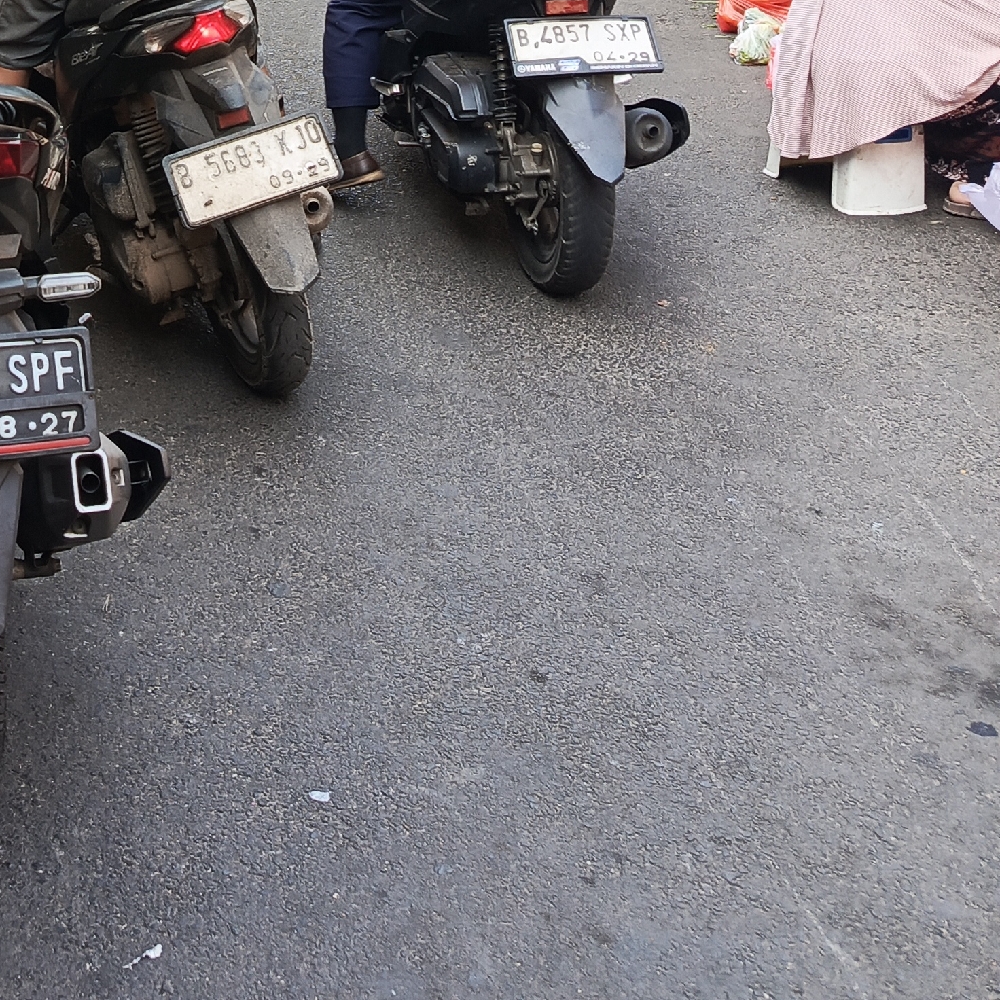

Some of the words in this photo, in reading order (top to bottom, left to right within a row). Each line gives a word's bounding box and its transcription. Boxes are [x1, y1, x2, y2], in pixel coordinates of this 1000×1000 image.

[516, 29, 529, 46] B
[541, 24, 589, 44] 4857
[604, 23, 641, 41] SXP
[526, 63, 556, 72] YAMAHA
[174, 163, 193, 189] B
[206, 140, 265, 177] 5683
[8, 350, 73, 394] SPF
